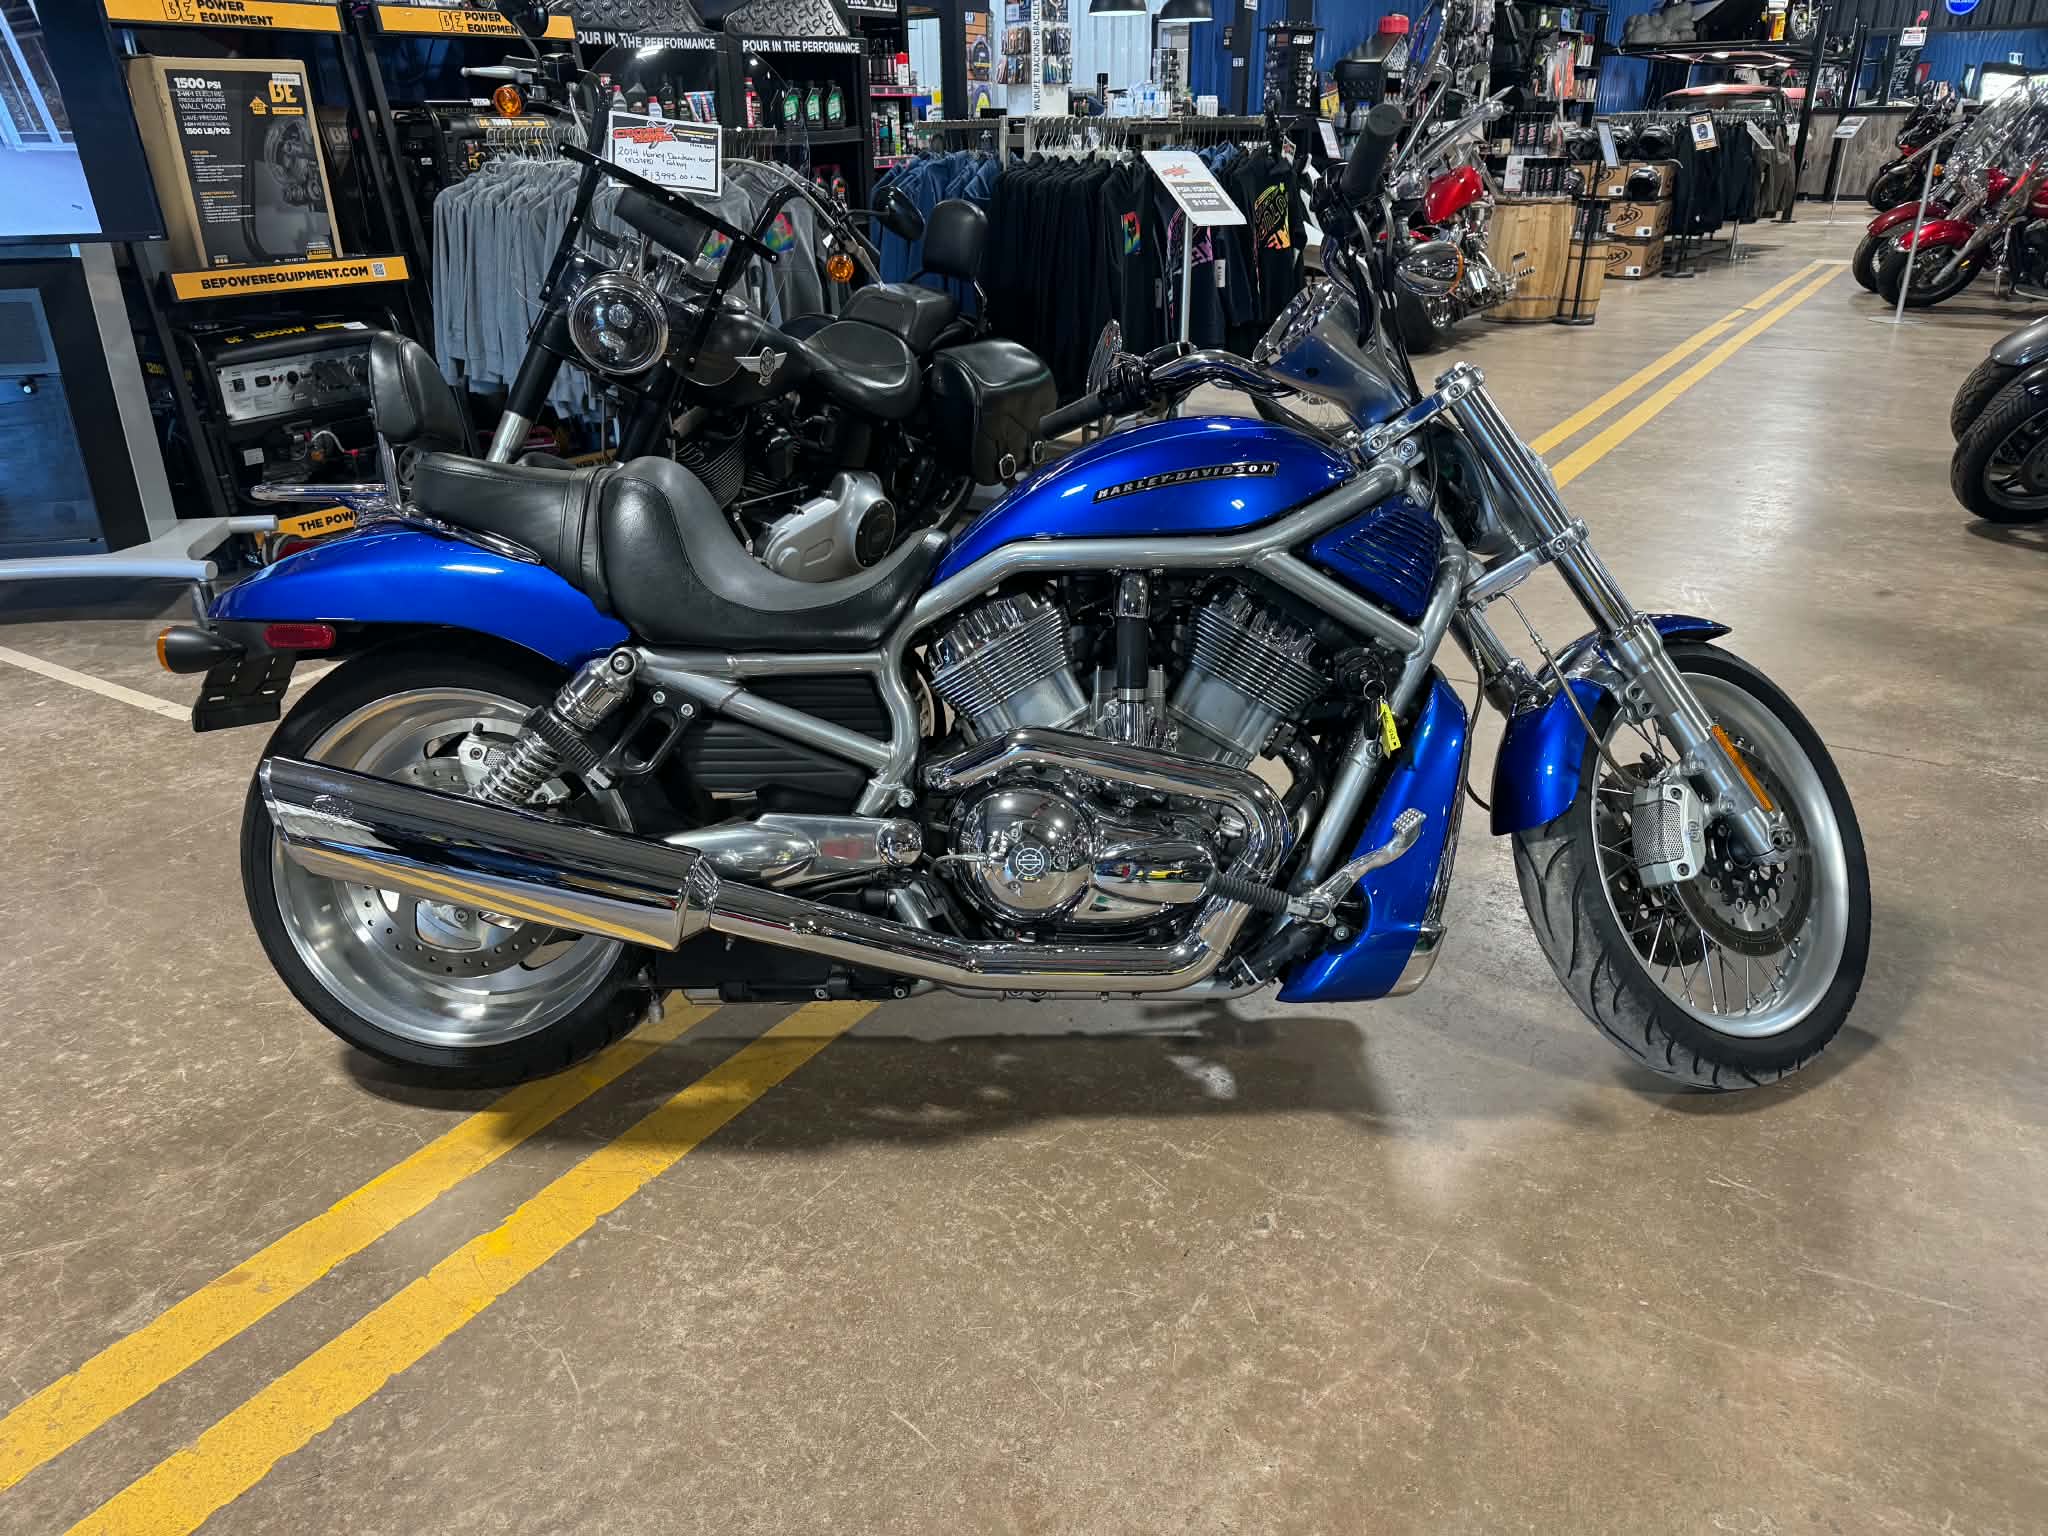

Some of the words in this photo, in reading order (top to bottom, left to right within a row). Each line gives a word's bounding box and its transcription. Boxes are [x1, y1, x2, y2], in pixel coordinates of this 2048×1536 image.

[197, 0, 245, 11] POWER
[200, 12, 274, 26] EQUIPMENT
[465, 12, 501, 22] POWER
[467, 24, 521, 35] EQUIPMEN
[577, 31, 602, 45] OUR
[644, 37, 716, 49] PERFORMANCE
[742, 40, 770, 52] POUR
[772, 40, 782, 52] IN
[783, 41, 801, 52] THE
[802, 41, 861, 54] PERFORMANCE
[173, 77, 206, 89] 1500
[206, 81, 222, 89] PSI
[201, 265, 369, 290] BEPOWEREQUIPMENT.COM
[1097, 464, 1271, 499] HARLEY-DAVIDSON
[298, 518, 324, 532] THE
[325, 510, 357, 526] POW
